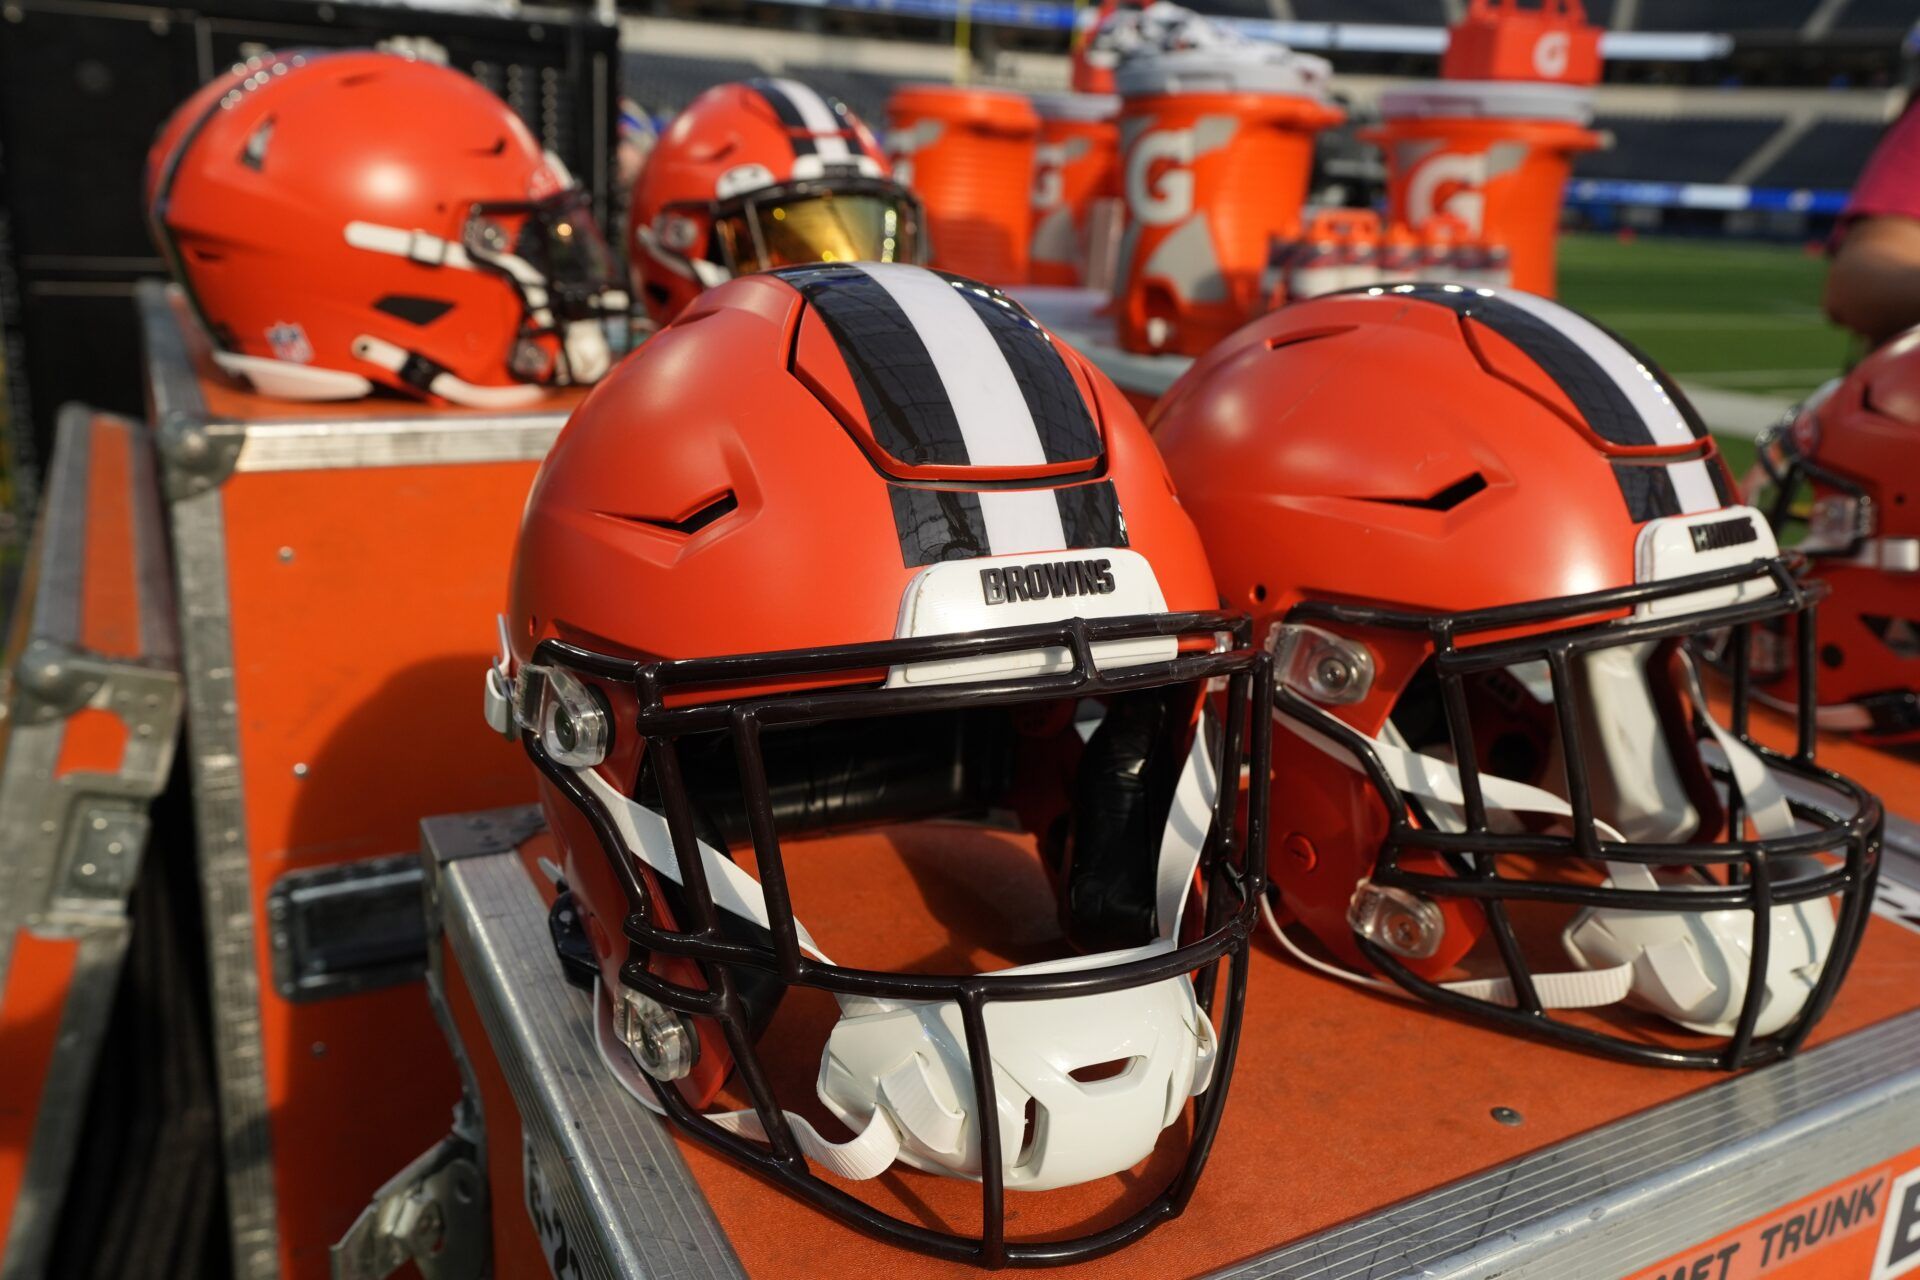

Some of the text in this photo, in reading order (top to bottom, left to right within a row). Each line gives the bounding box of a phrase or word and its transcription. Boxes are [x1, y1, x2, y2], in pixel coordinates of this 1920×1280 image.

[1534, 31, 1568, 78] G
[1128, 129, 1195, 226] G
[980, 558, 1115, 606] BROWNS
[1760, 1178, 1884, 1268] TRUNK
